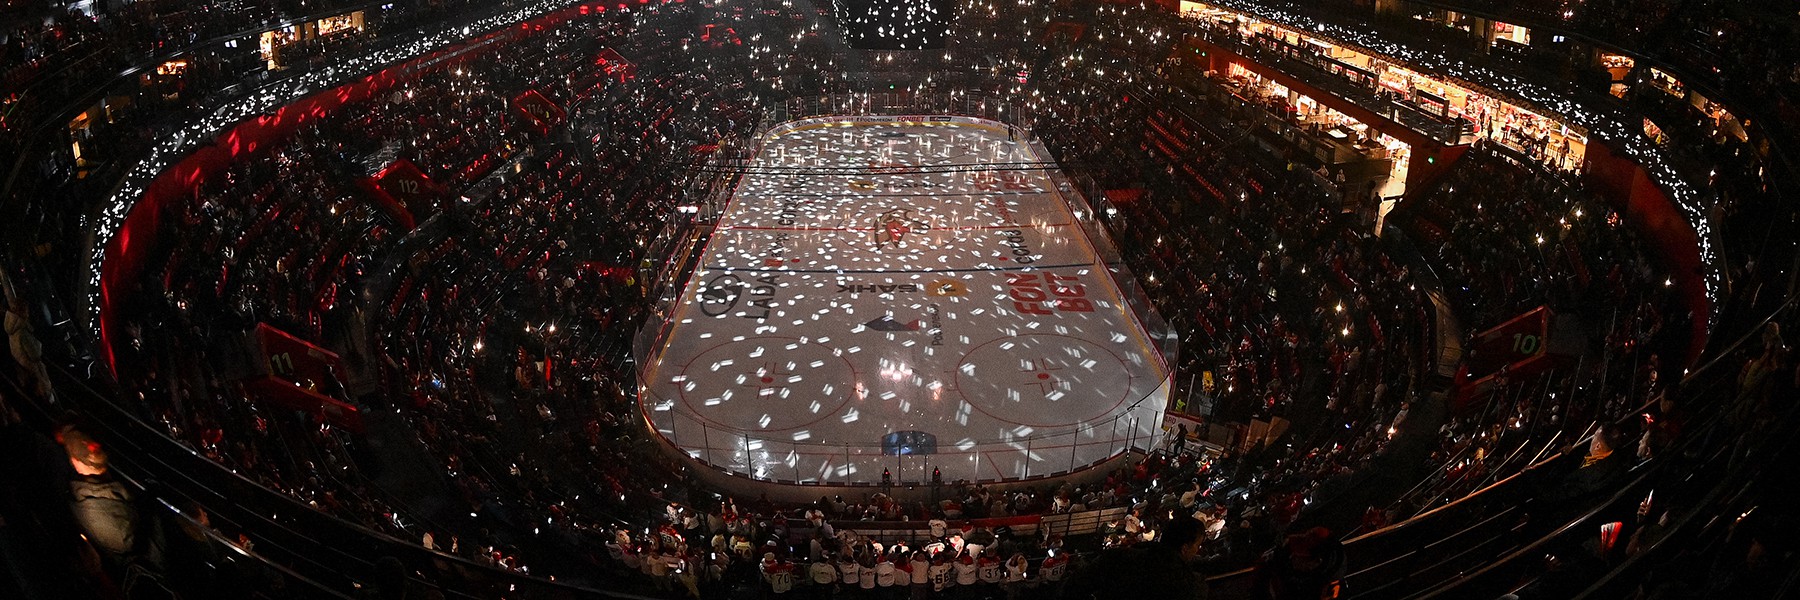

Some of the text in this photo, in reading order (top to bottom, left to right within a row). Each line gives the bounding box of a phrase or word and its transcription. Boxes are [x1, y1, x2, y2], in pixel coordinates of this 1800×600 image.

[398, 179, 419, 194] 112
[743, 274, 780, 320] LADA
[1005, 272, 1053, 315] FON
[1043, 271, 1095, 312] BET
[929, 303, 944, 346] Роселеком
[1513, 333, 1541, 354] 10
[775, 574, 790, 584] 70
